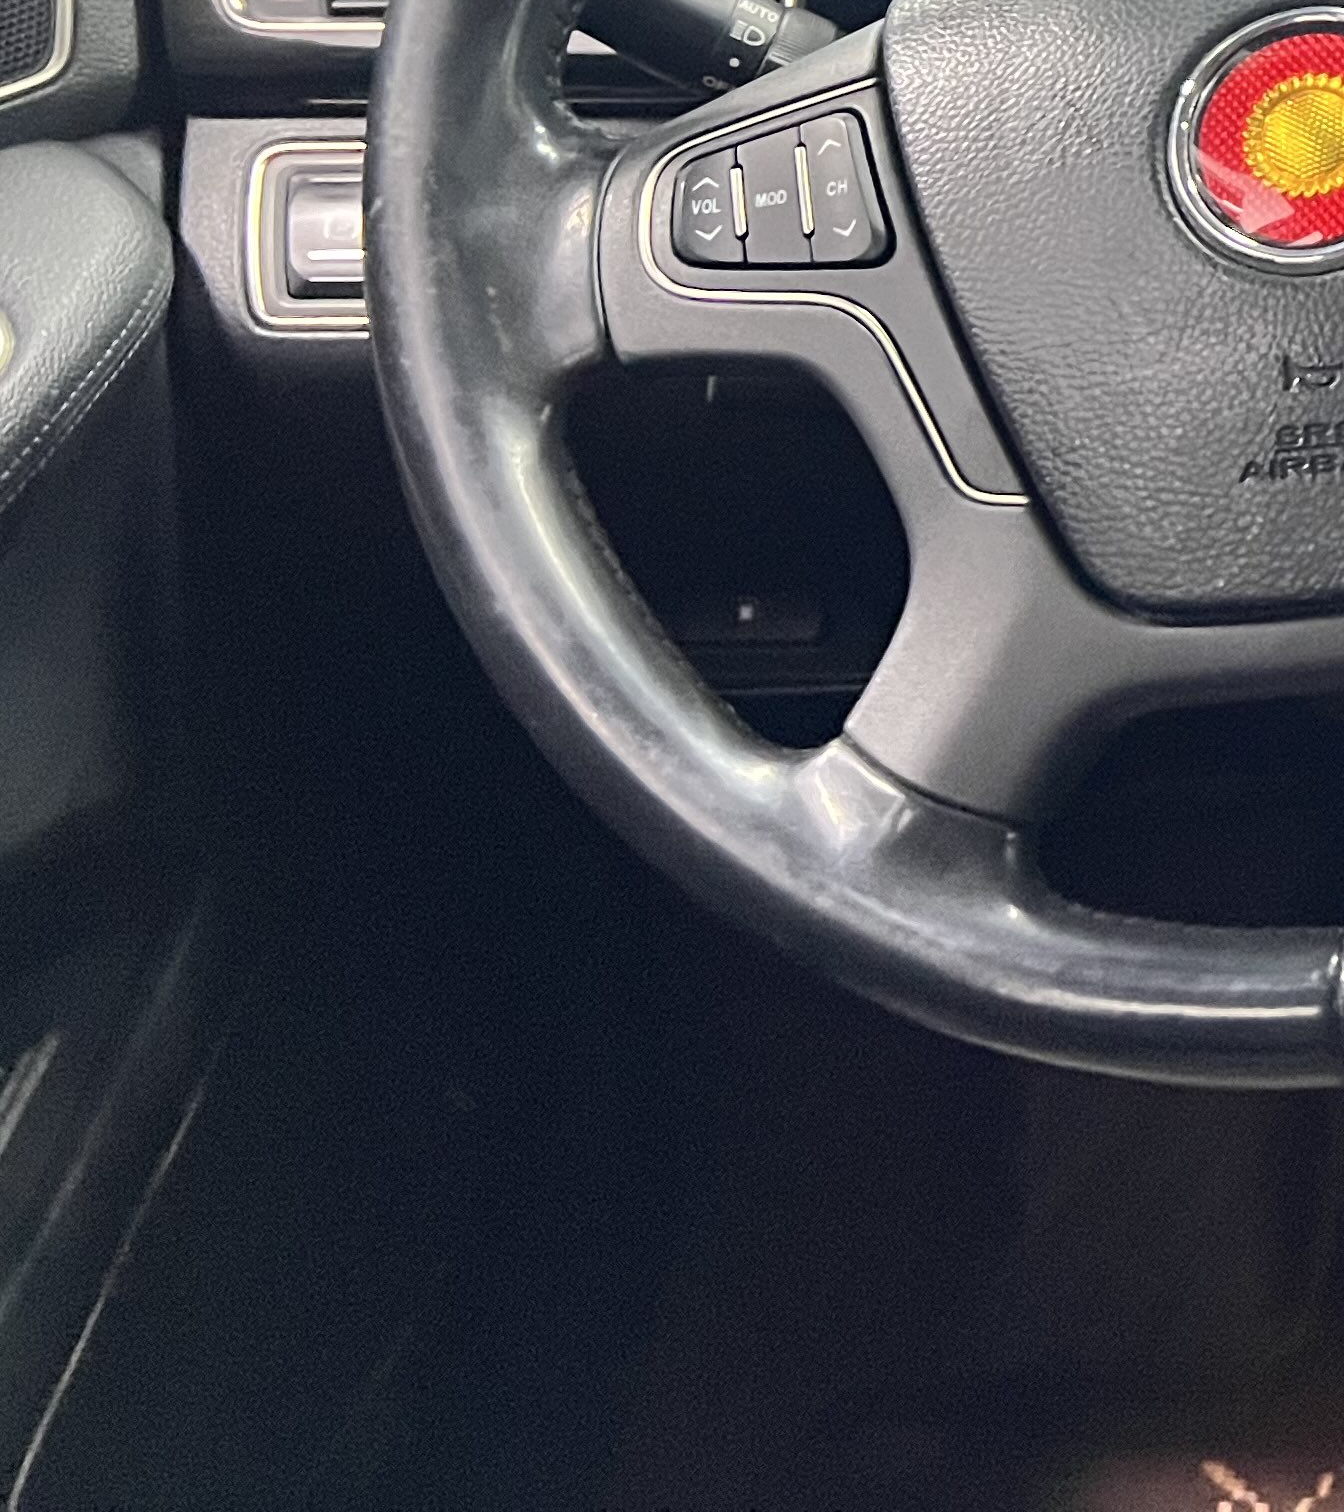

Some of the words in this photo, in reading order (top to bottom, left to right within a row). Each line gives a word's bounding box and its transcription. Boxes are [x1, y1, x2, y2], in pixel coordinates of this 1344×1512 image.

[738, 0, 779, 23] AUTO
[826, 179, 848, 196] CH
[691, 199, 722, 215] VOL
[754, 190, 788, 208] MOD
